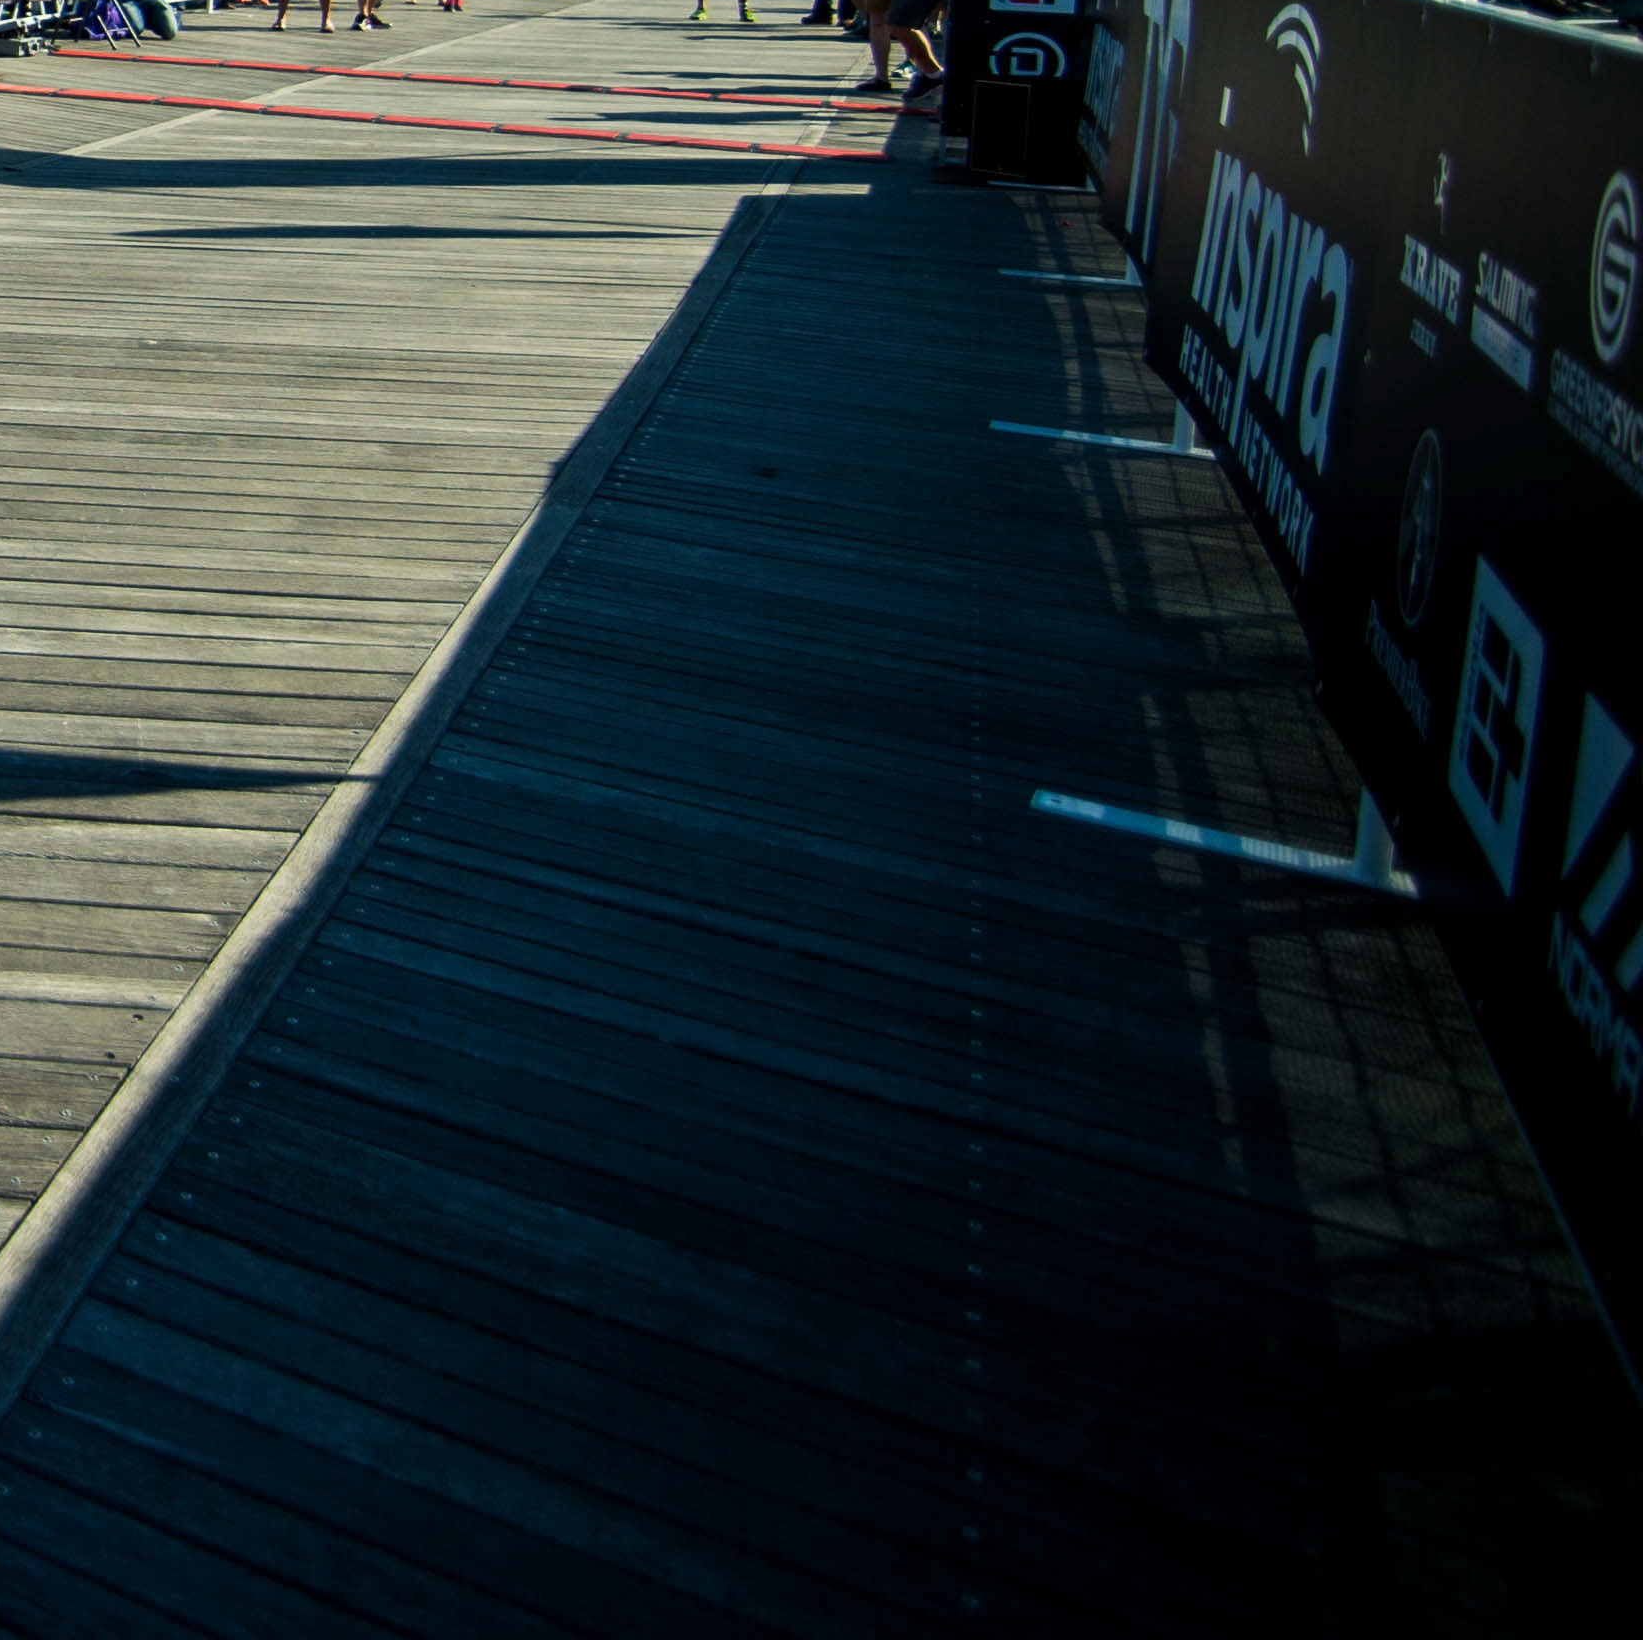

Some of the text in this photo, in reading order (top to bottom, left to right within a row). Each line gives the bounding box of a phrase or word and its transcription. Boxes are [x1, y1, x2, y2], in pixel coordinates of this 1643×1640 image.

[1192, 85, 1352, 476] inspira
[1400, 233, 1464, 326] KRAVE
[1179, 323, 1235, 434] HEALTH
[1550, 346, 1643, 466] GREENEPSYC
